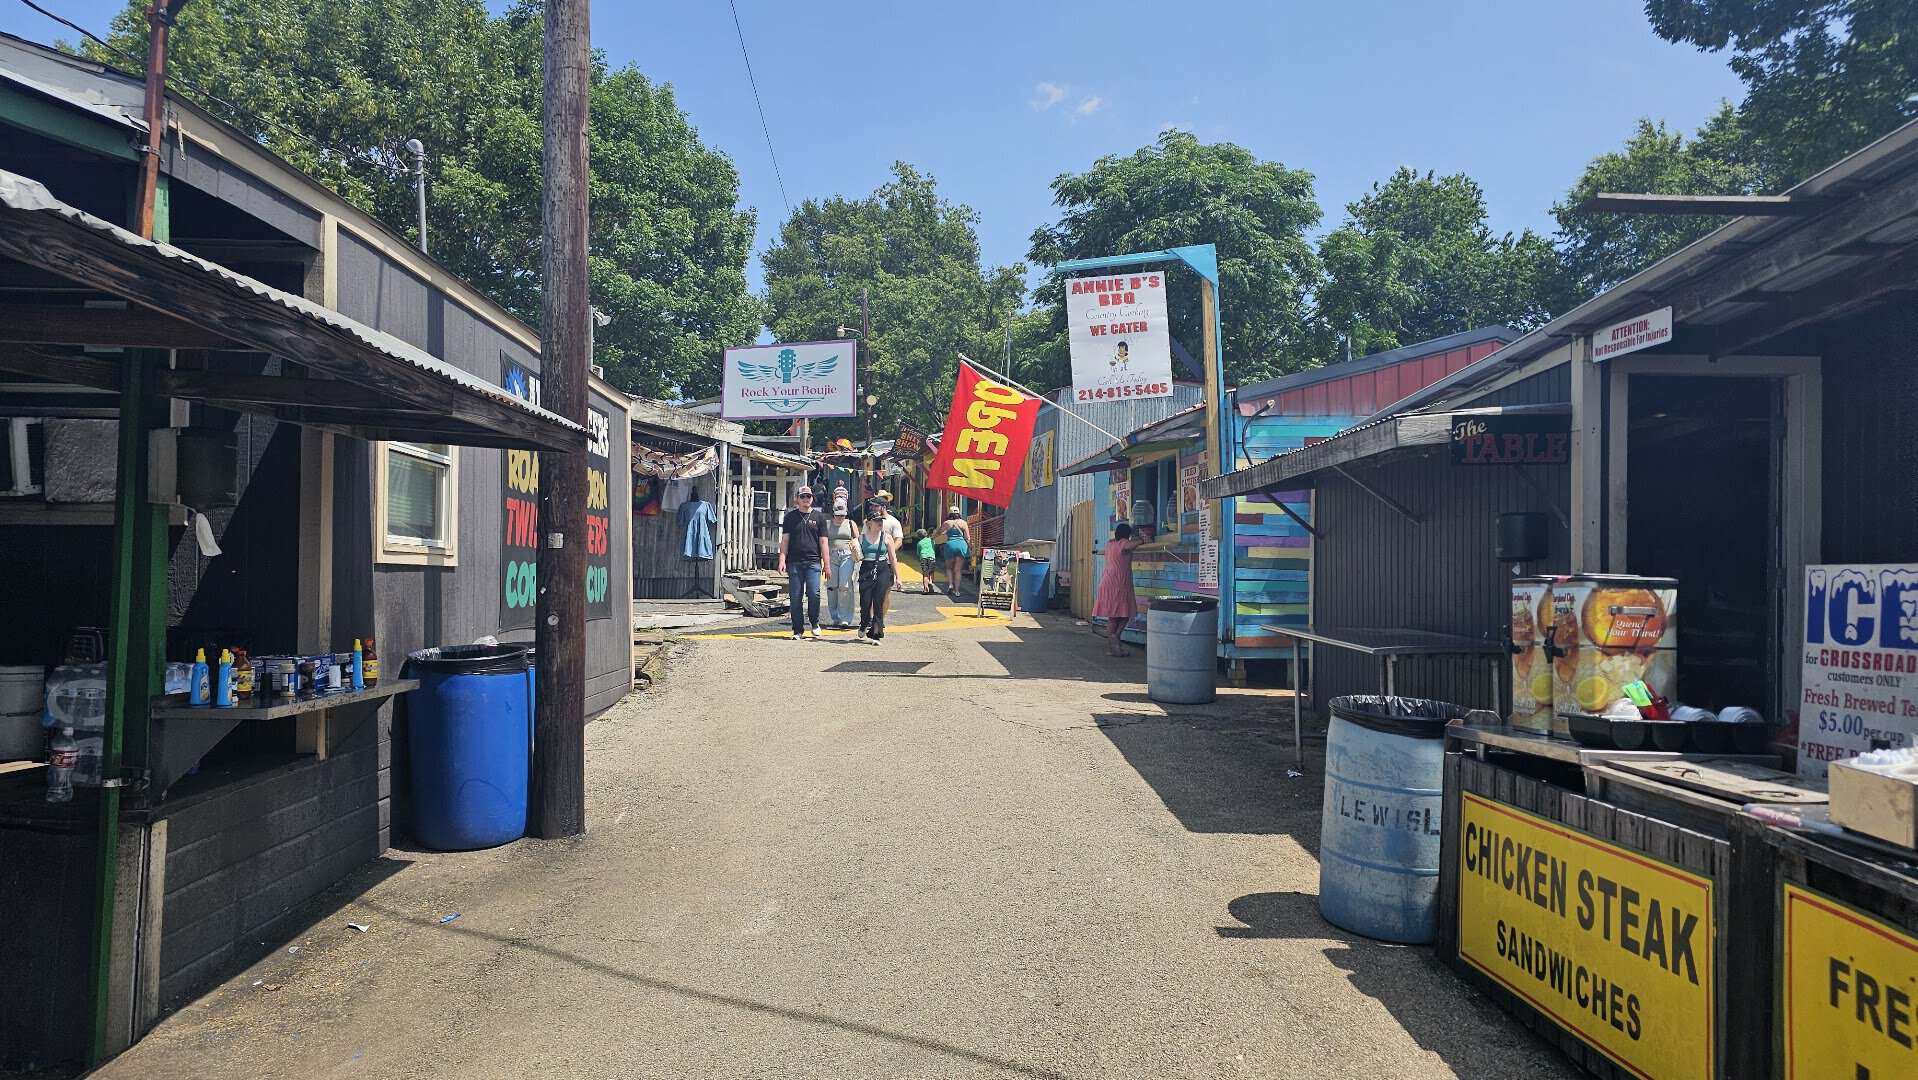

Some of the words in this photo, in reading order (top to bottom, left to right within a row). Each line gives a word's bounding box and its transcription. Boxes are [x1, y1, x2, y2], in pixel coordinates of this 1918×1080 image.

[1072, 278, 1124, 294] ANNIE
[1130, 276, 1160, 290] B'S
[1098, 292, 1136, 307] BBQ
[1090, 325, 1107, 337] WE
[1111, 321, 1148, 334] CATER
[1611, 319, 1650, 341] ATTENTION:
[1636, 334, 1645, 345] For
[1645, 328, 1668, 342] Injuries
[741, 388, 769, 399] Rock
[771, 386, 799, 397] Your
[801, 385, 837, 397] Boujie
[1453, 419, 1488, 441] The
[1461, 432, 1568, 465] TABLE
[1807, 569, 1918, 649] ICE
[1805, 652, 1818, 665] for
[1827, 671, 1874, 686] customers
[1876, 674, 1902, 688] ONLY
[1804, 688, 1840, 708] Fresh
[1844, 693, 1896, 715] Brewed
[1819, 709, 1864, 736] $5.00
[1863, 726, 1881, 741] per
[1884, 730, 1905, 746] cup
[1465, 821, 1568, 918] CHICKEN
[1577, 869, 1700, 986] STEAK
[1496, 919, 1642, 1041] SANDWICHES
[1829, 956, 1918, 1050] FRE
